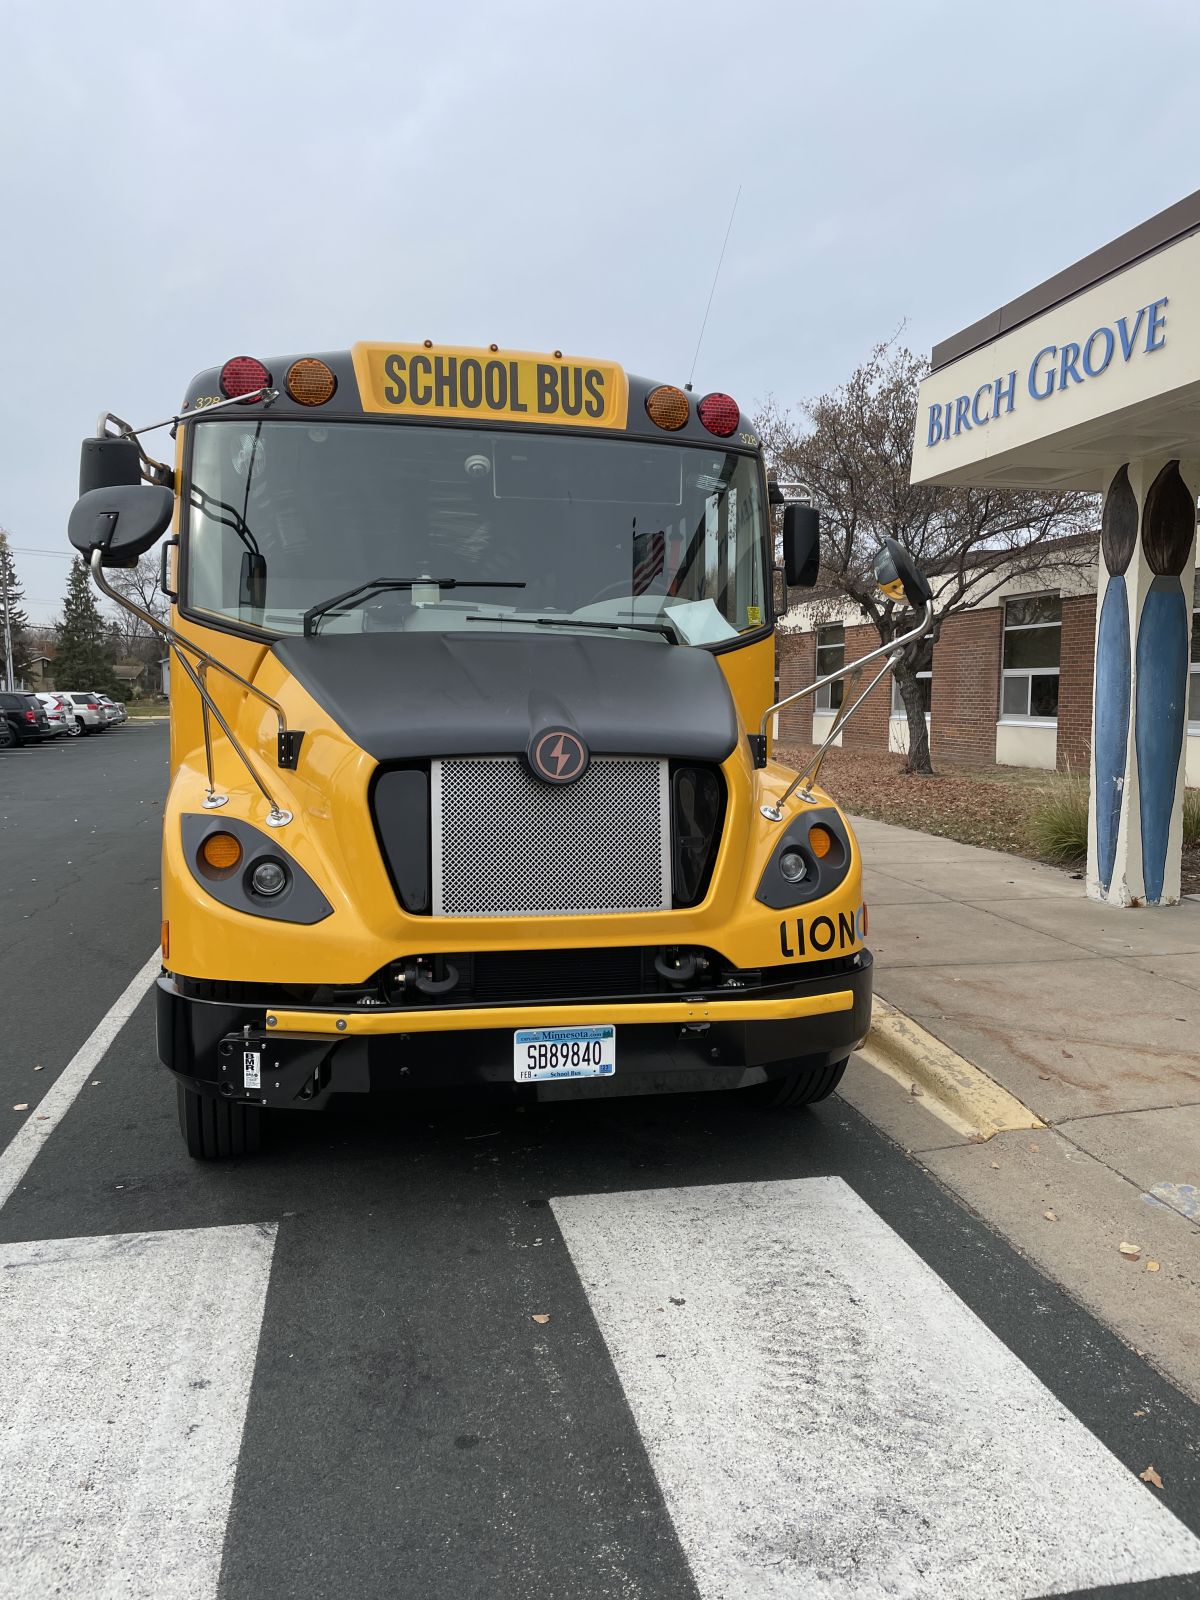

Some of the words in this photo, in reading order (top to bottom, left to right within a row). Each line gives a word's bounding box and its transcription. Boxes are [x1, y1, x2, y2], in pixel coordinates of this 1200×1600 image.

[926, 370, 1017, 447] BIRCH
[1027, 296, 1169, 400] GROVE
[384, 353, 528, 413] SCHOOL
[536, 363, 605, 418] BUS
[195, 396, 221, 410] 328
[739, 432, 758, 446] 328
[542, 1031, 588, 1040] Minnesota
[528, 1041, 602, 1070] SB89840
